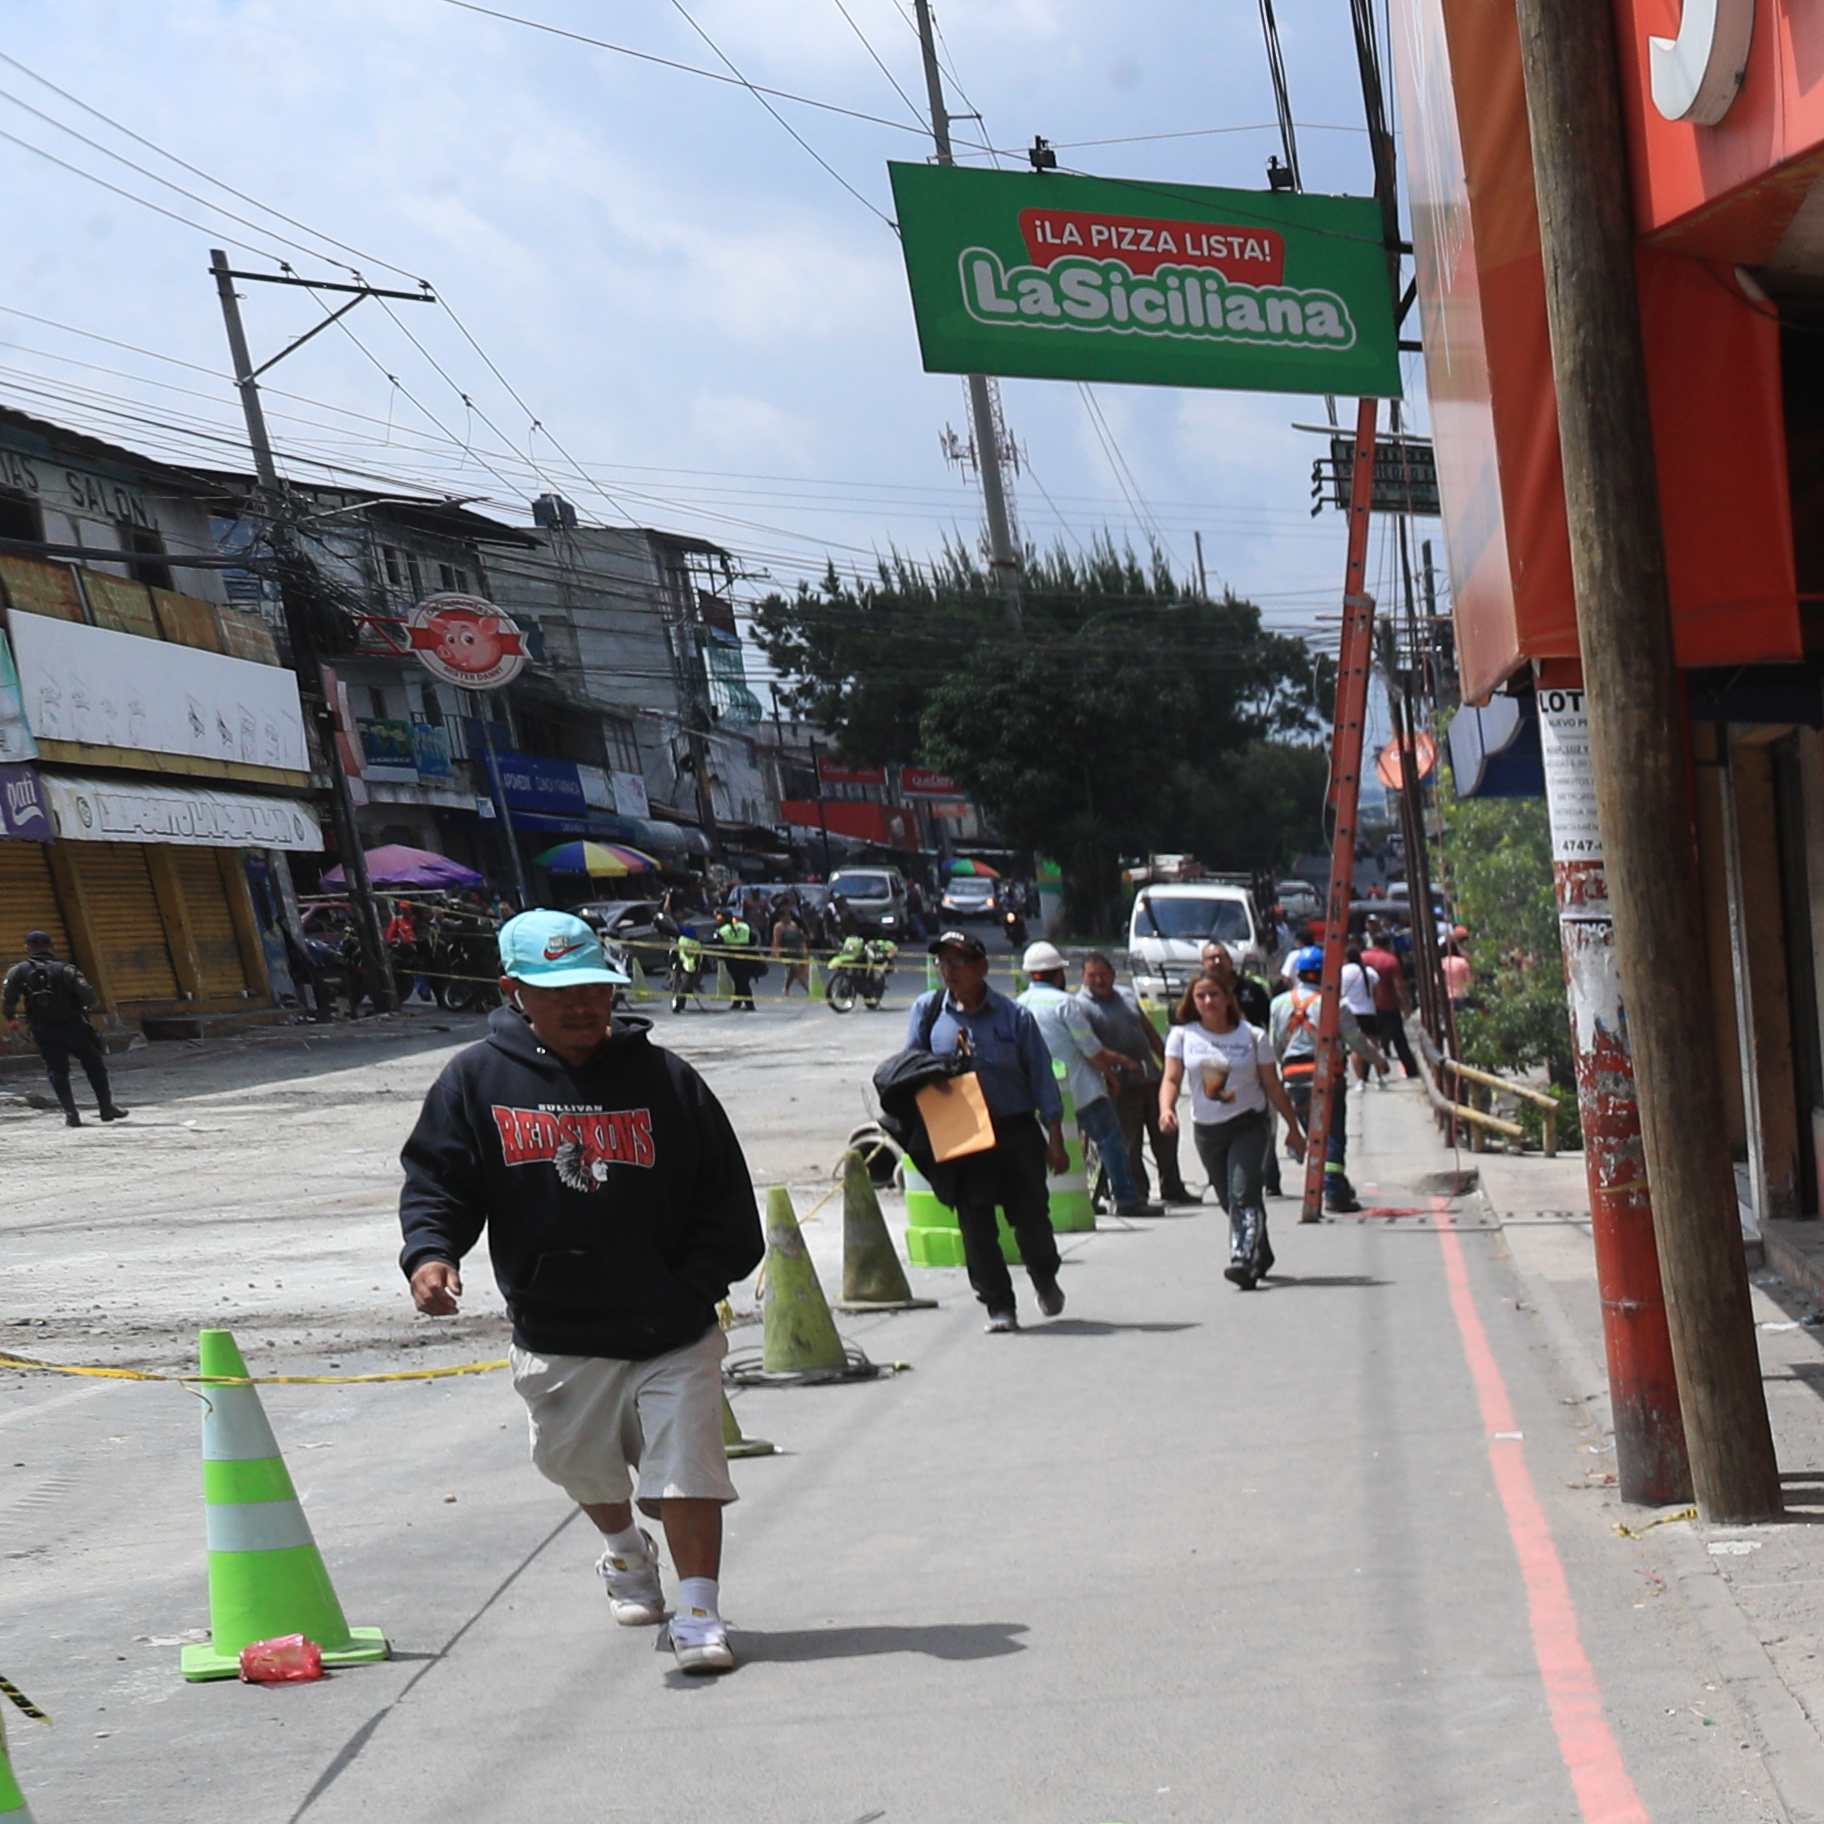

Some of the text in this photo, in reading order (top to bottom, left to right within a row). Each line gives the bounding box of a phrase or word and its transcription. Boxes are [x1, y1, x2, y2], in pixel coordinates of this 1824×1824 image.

[1091, 225, 1178, 254] PIZZA
[1184, 233, 1272, 262] LISTA!
[972, 259, 1345, 339] LaSiciliana
[65, 471, 149, 529] SALON
[491, 1105, 656, 1168] REDSKINS
[538, 1103, 604, 1113] SULLIVAN
